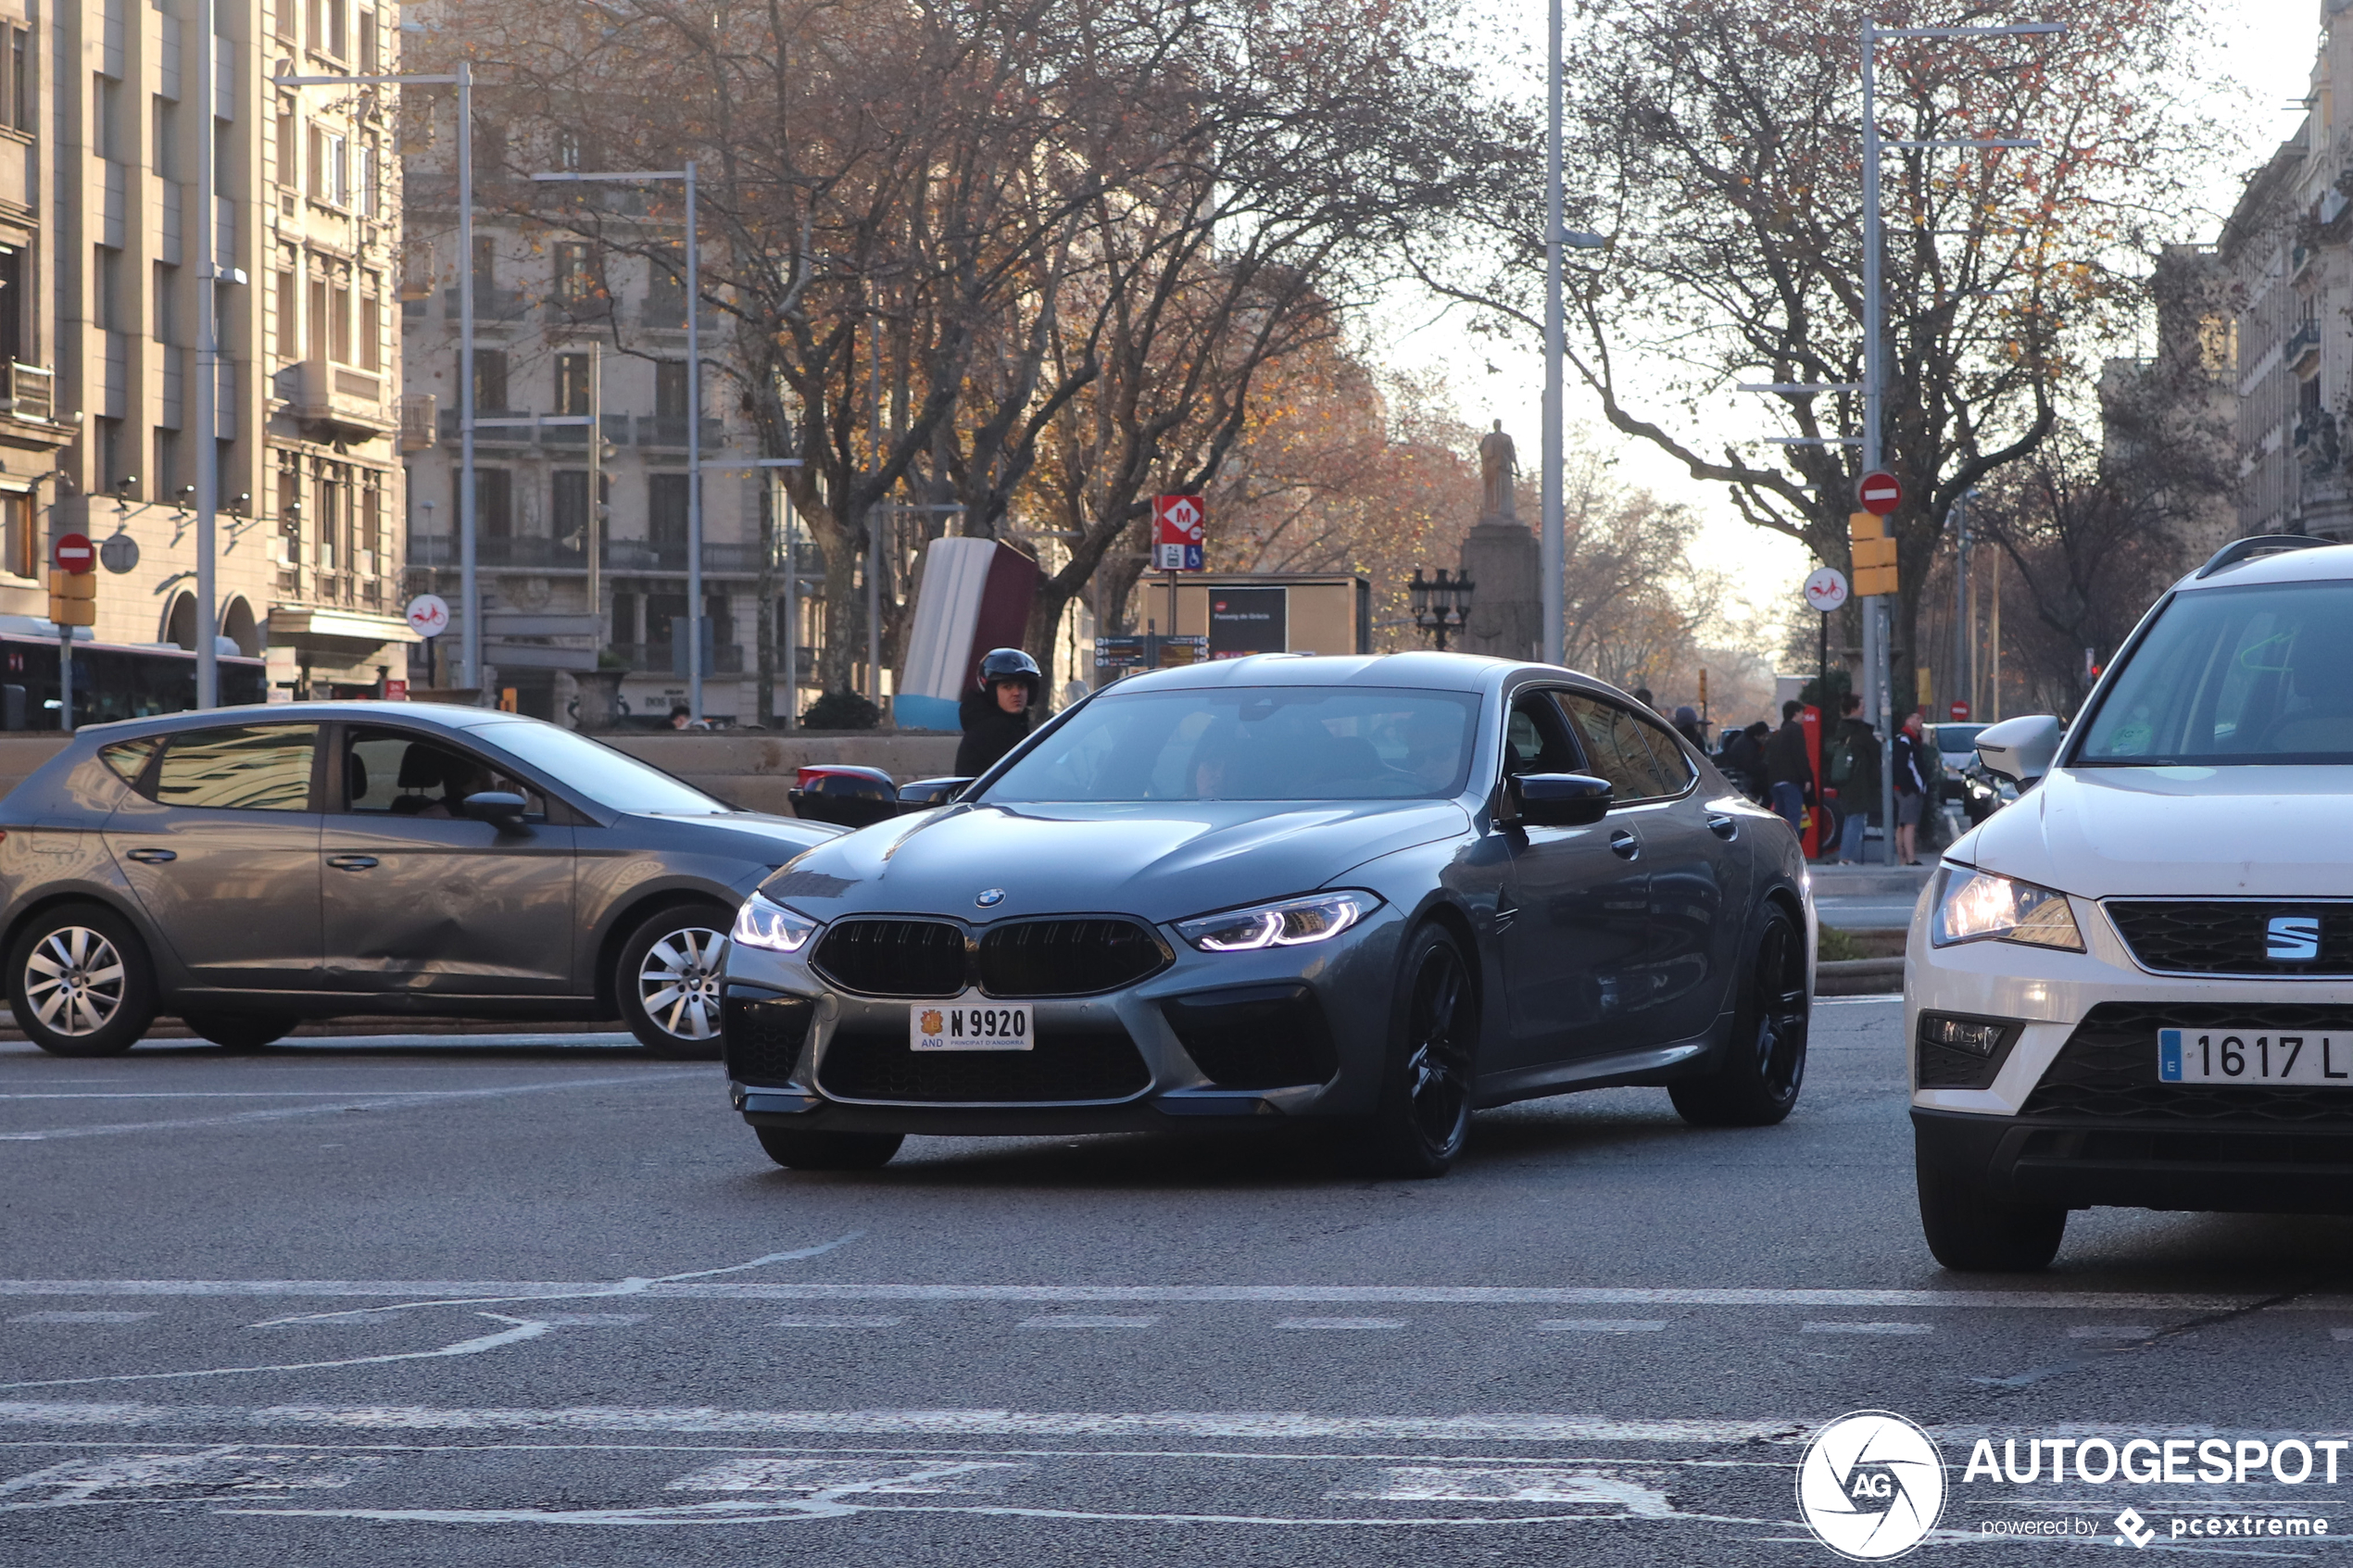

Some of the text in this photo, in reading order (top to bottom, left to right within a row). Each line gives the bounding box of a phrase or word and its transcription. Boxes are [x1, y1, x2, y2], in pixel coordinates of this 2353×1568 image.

[1176, 508, 1190, 523] M
[950, 1010, 1026, 1037] N 9920
[921, 1038, 944, 1047] AND
[2198, 1035, 2348, 1079] 1617 L
[2168, 1060, 2175, 1072] E
